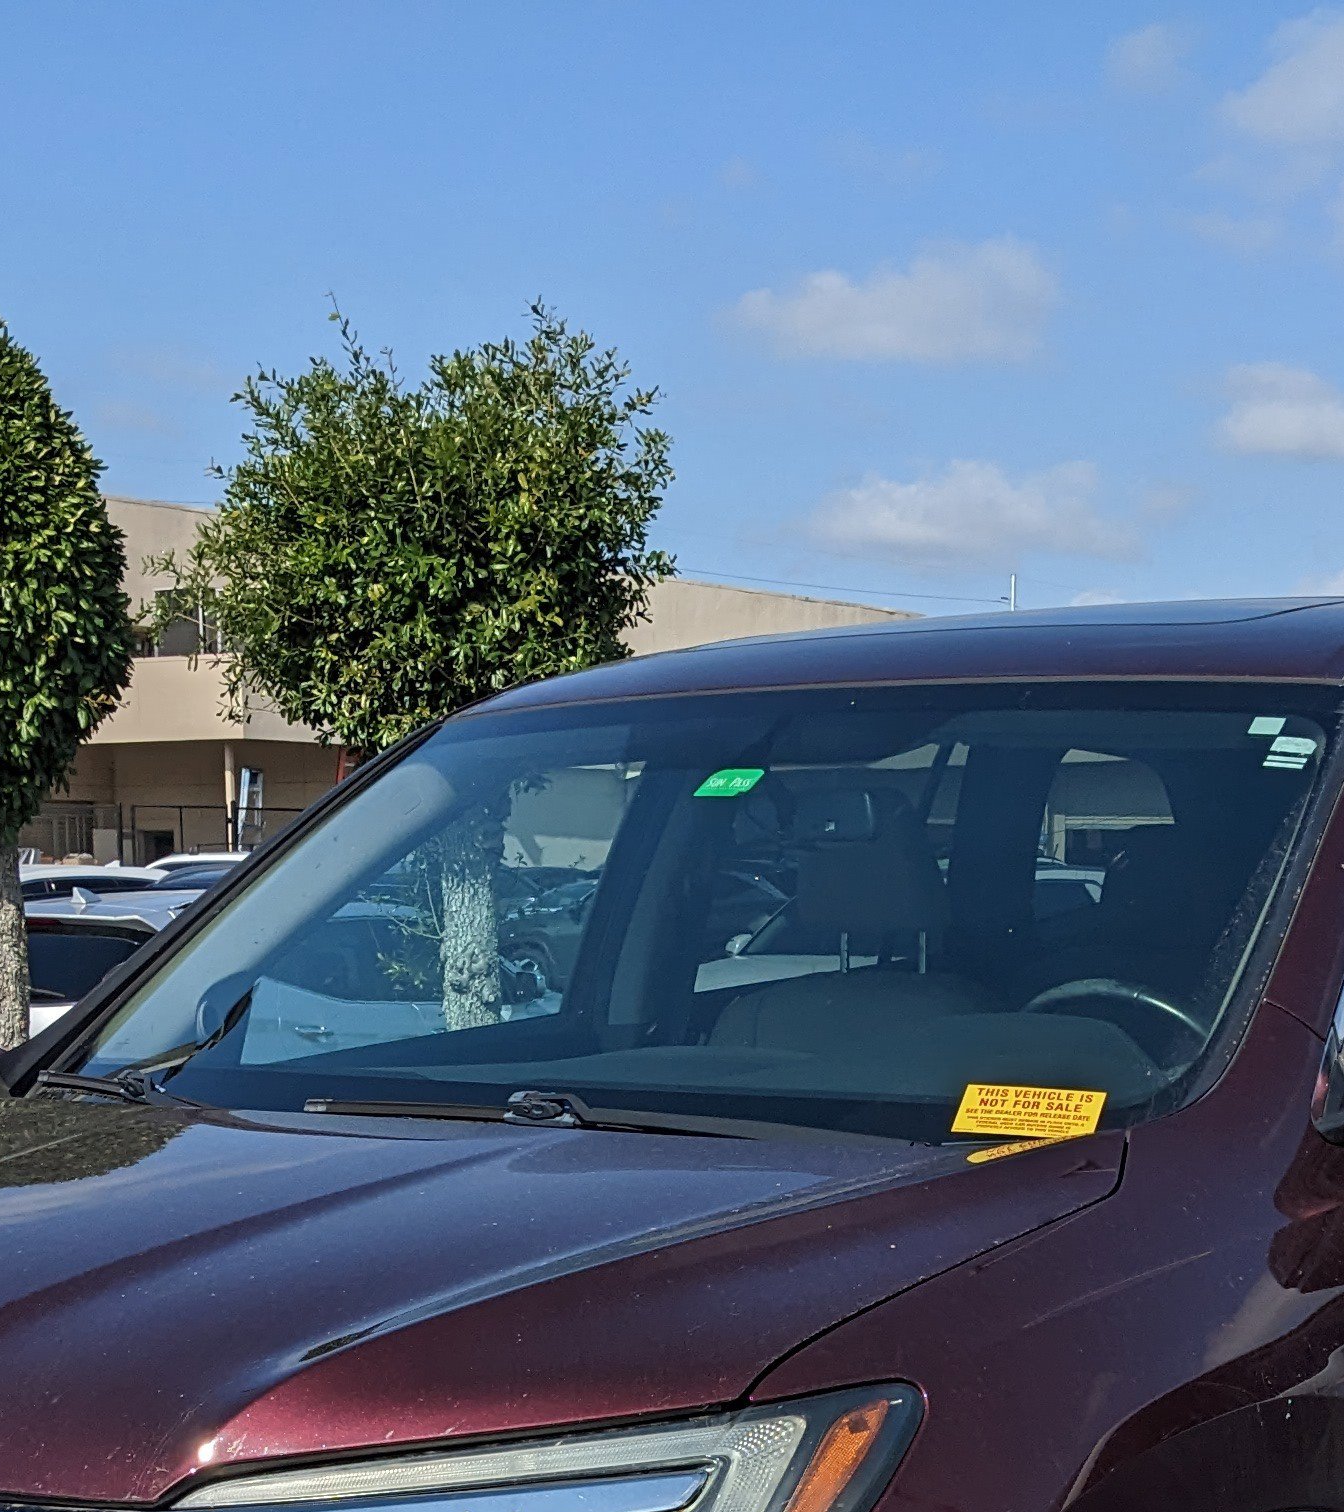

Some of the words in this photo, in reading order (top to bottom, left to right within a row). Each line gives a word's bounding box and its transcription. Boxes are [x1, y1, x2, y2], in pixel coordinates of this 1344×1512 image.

[977, 1087, 1009, 1098] THIS
[1014, 1089, 1075, 1102] VEHICLE
[1079, 1093, 1094, 1103] IS
[979, 1097, 1008, 1108] NOT
[1013, 1099, 1041, 1110] FOR
[1046, 1101, 1084, 1113] SALE
[994, 1109, 1022, 1117] DEALER
[1040, 1112, 1071, 1120] RELEASE
[1072, 1114, 1091, 1122] DATE
